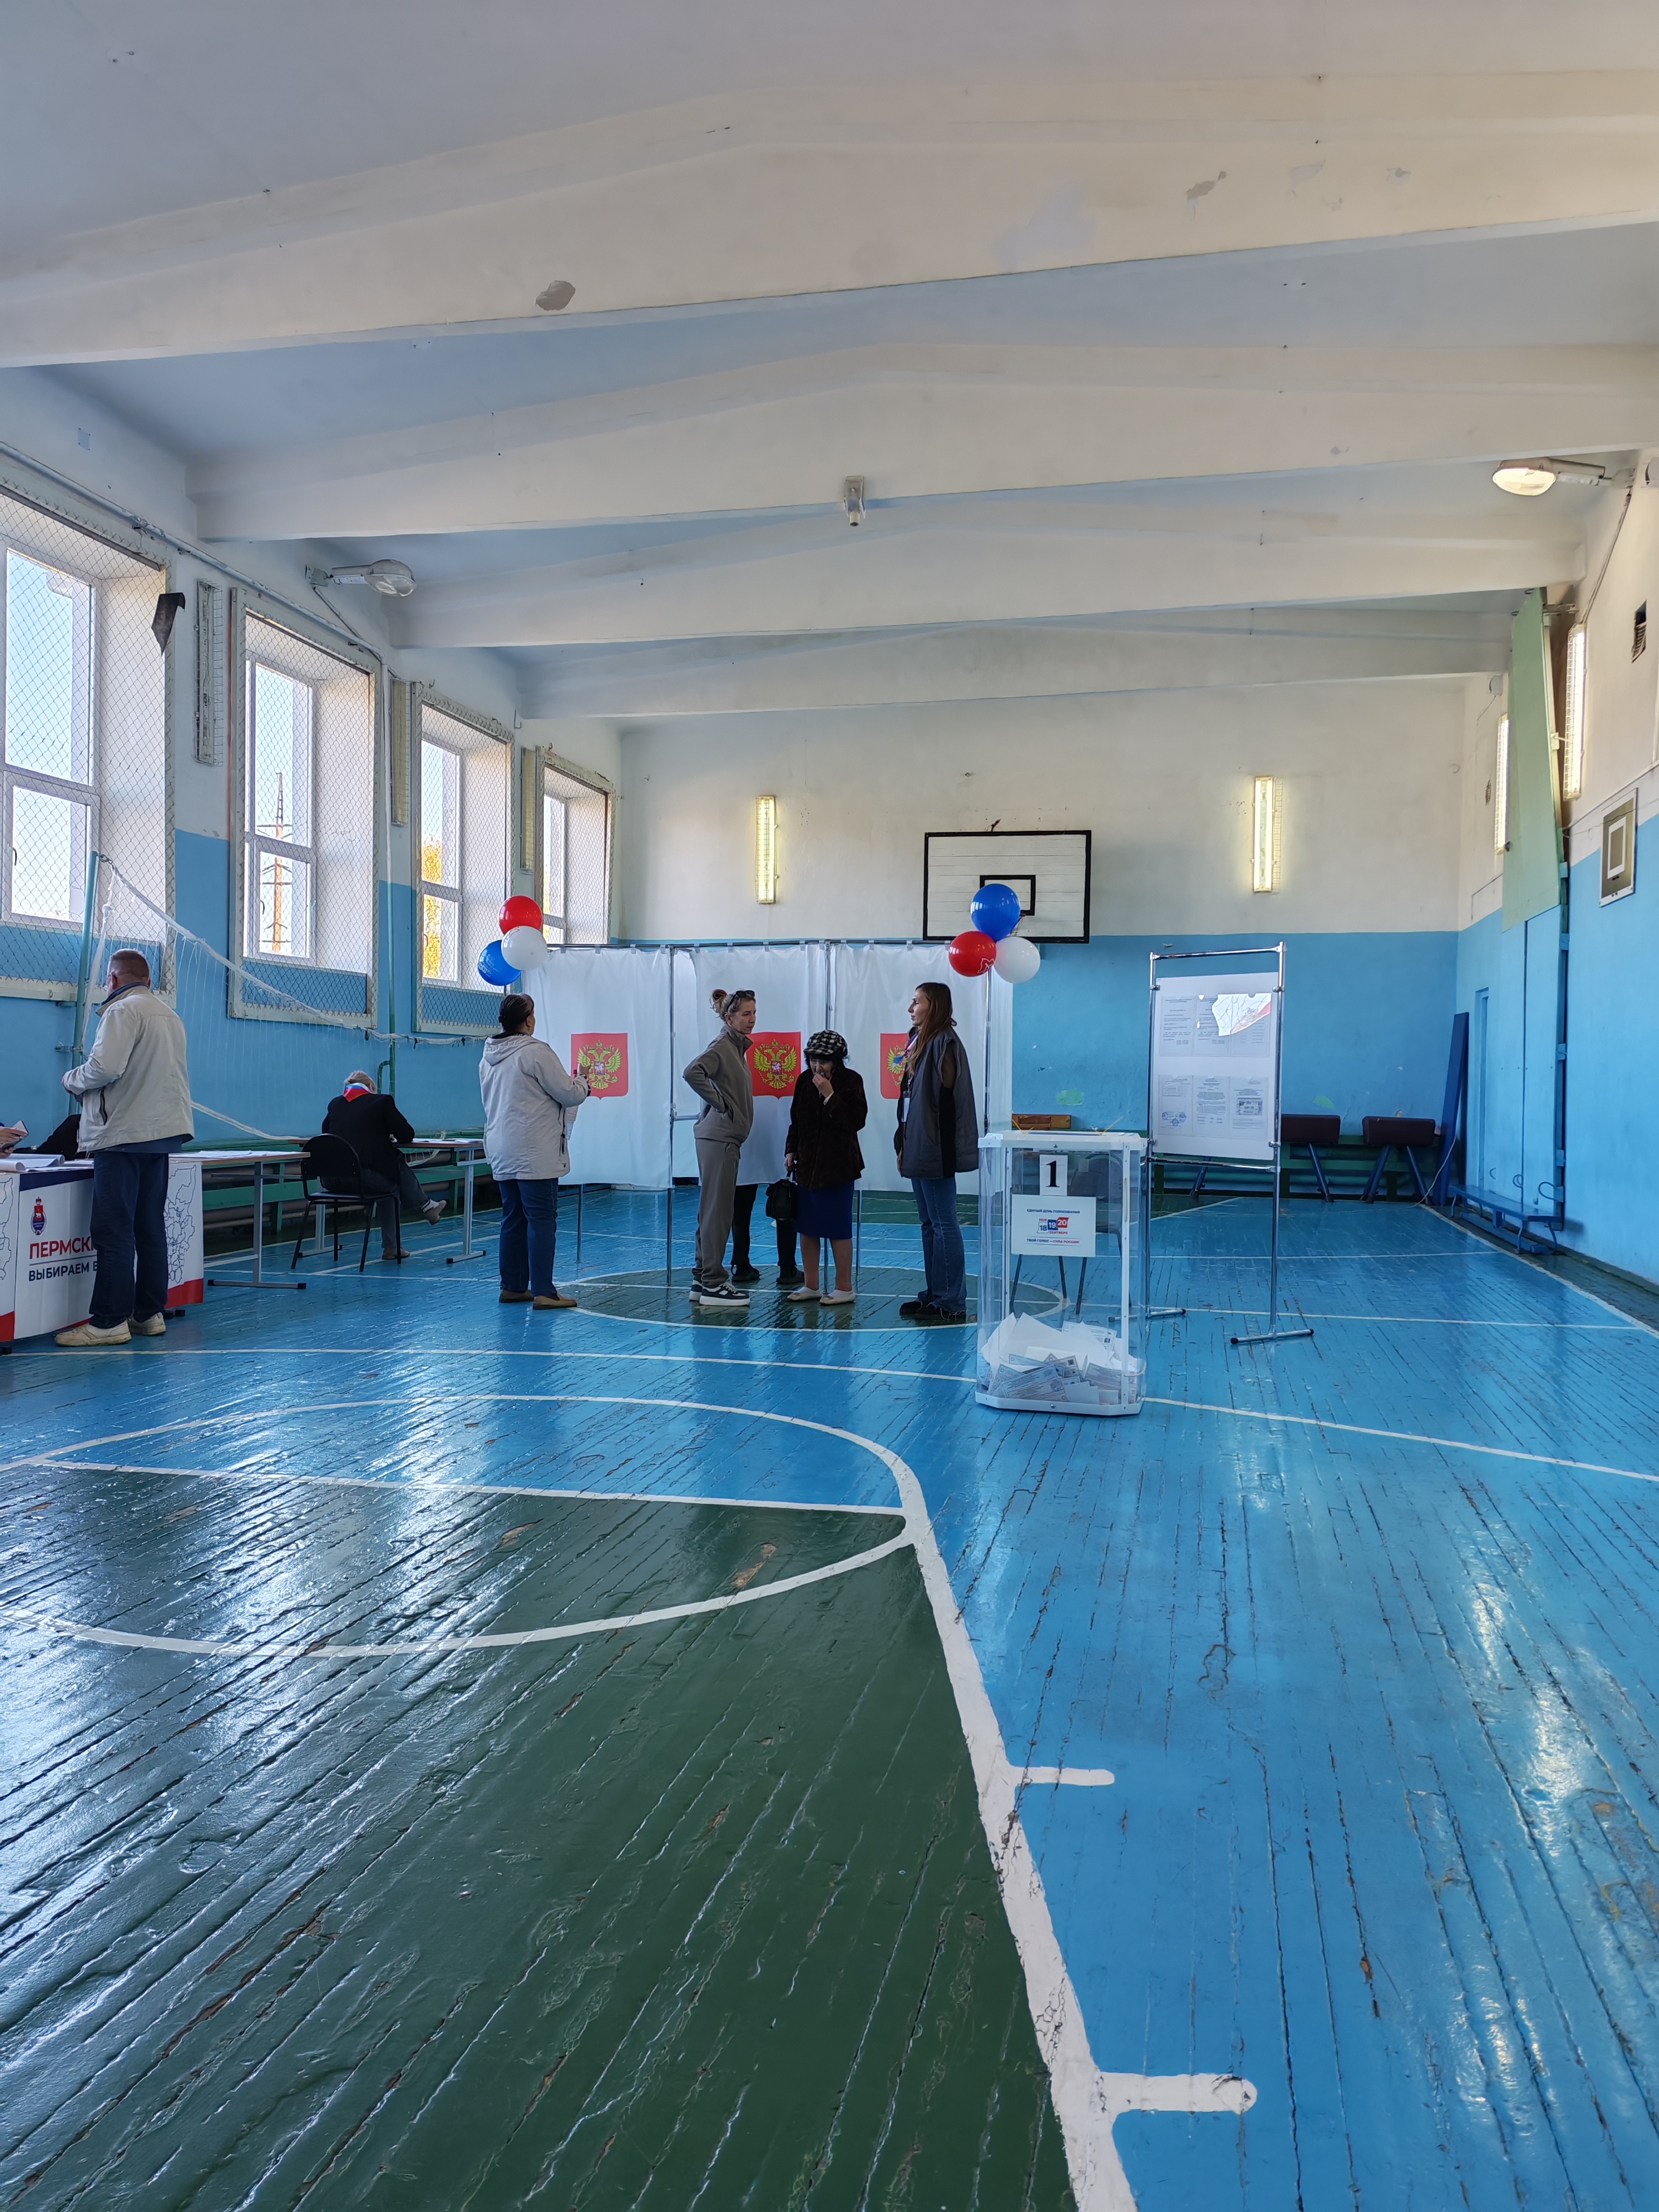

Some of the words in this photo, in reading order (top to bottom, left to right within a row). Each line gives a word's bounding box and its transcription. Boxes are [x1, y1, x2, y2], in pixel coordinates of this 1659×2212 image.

[1046, 1160, 1060, 1188] 1
[30, 1236, 95, 1259] ПЕРМСК
[29, 1262, 89, 1282] ВЫБИРАЕМ
